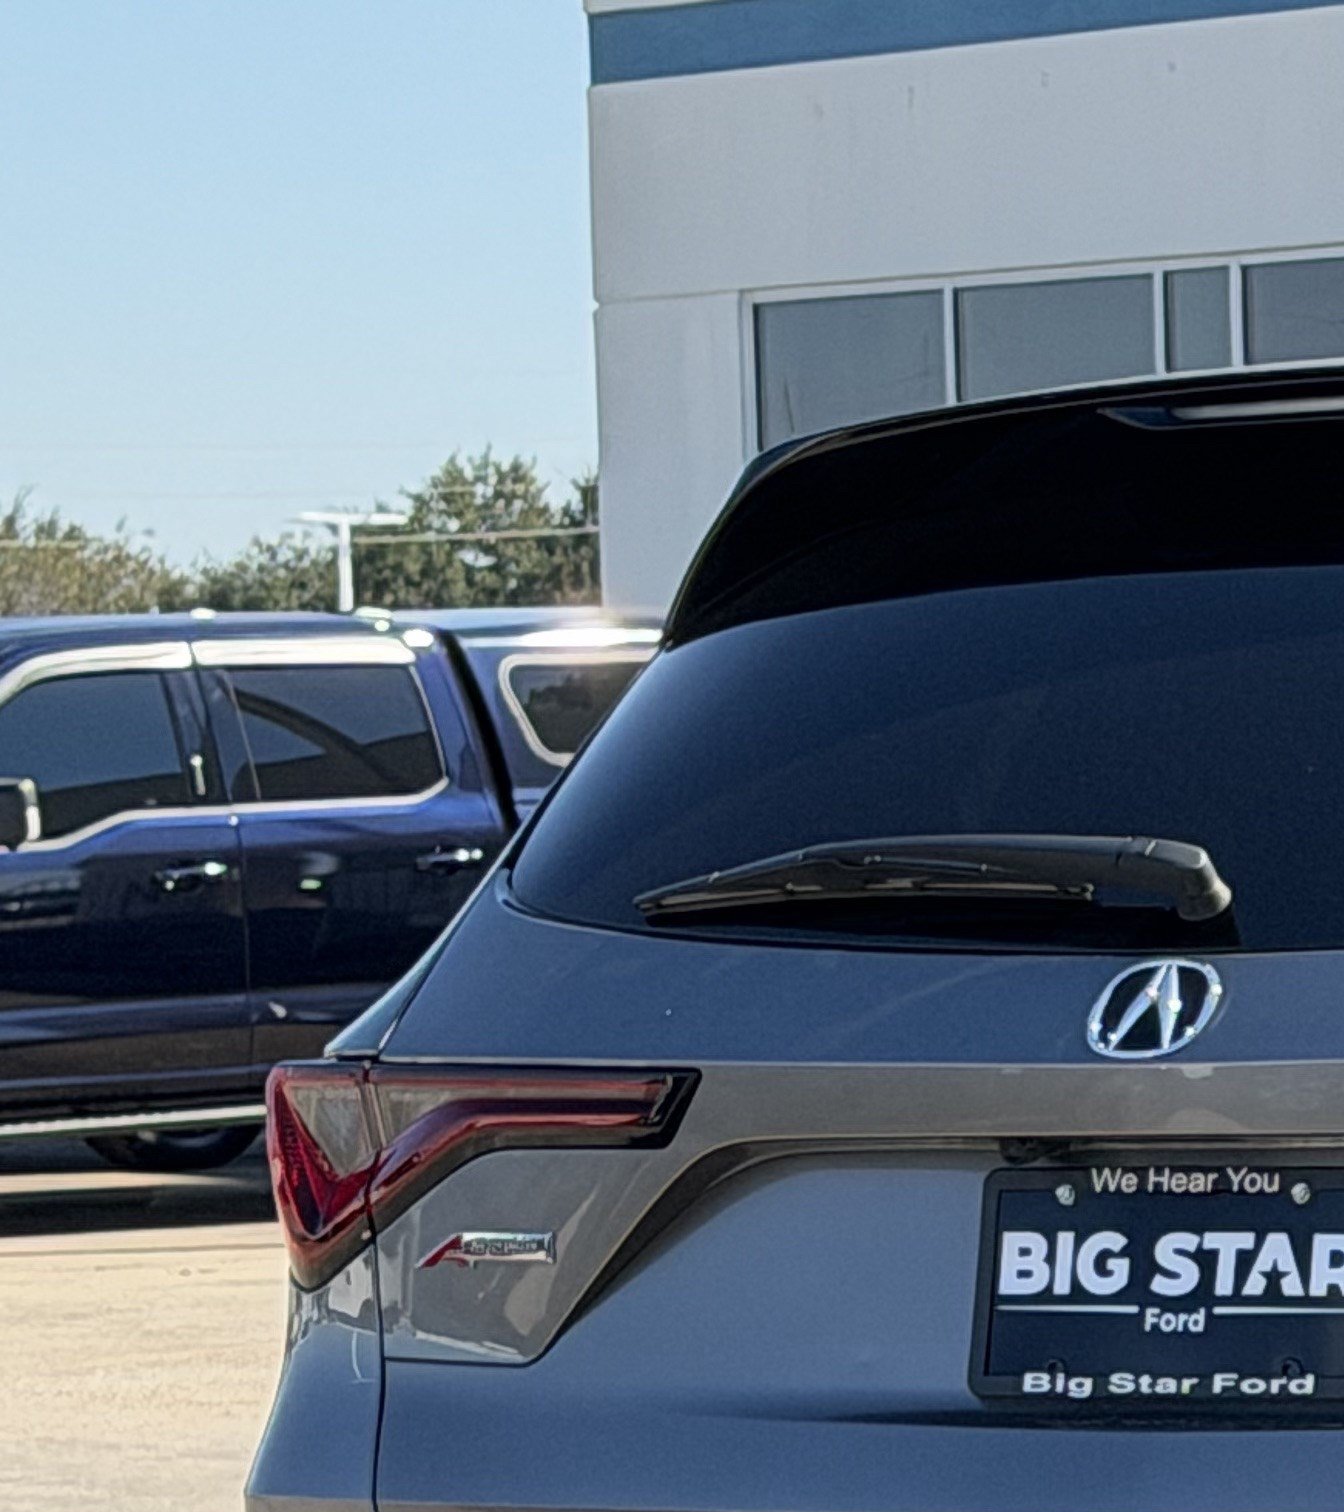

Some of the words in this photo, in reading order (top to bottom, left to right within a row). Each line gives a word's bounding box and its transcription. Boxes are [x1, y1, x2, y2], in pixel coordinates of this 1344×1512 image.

[1091, 1167, 1137, 1192] We
[1147, 1168, 1218, 1193] Hear
[1226, 1168, 1280, 1193] You
[999, 1231, 1131, 1295] BIG
[1144, 1308, 1206, 1332] Ford
[1022, 1373, 1093, 1397] Big
[1108, 1373, 1200, 1394] Star
[1211, 1373, 1316, 1394] Ford
